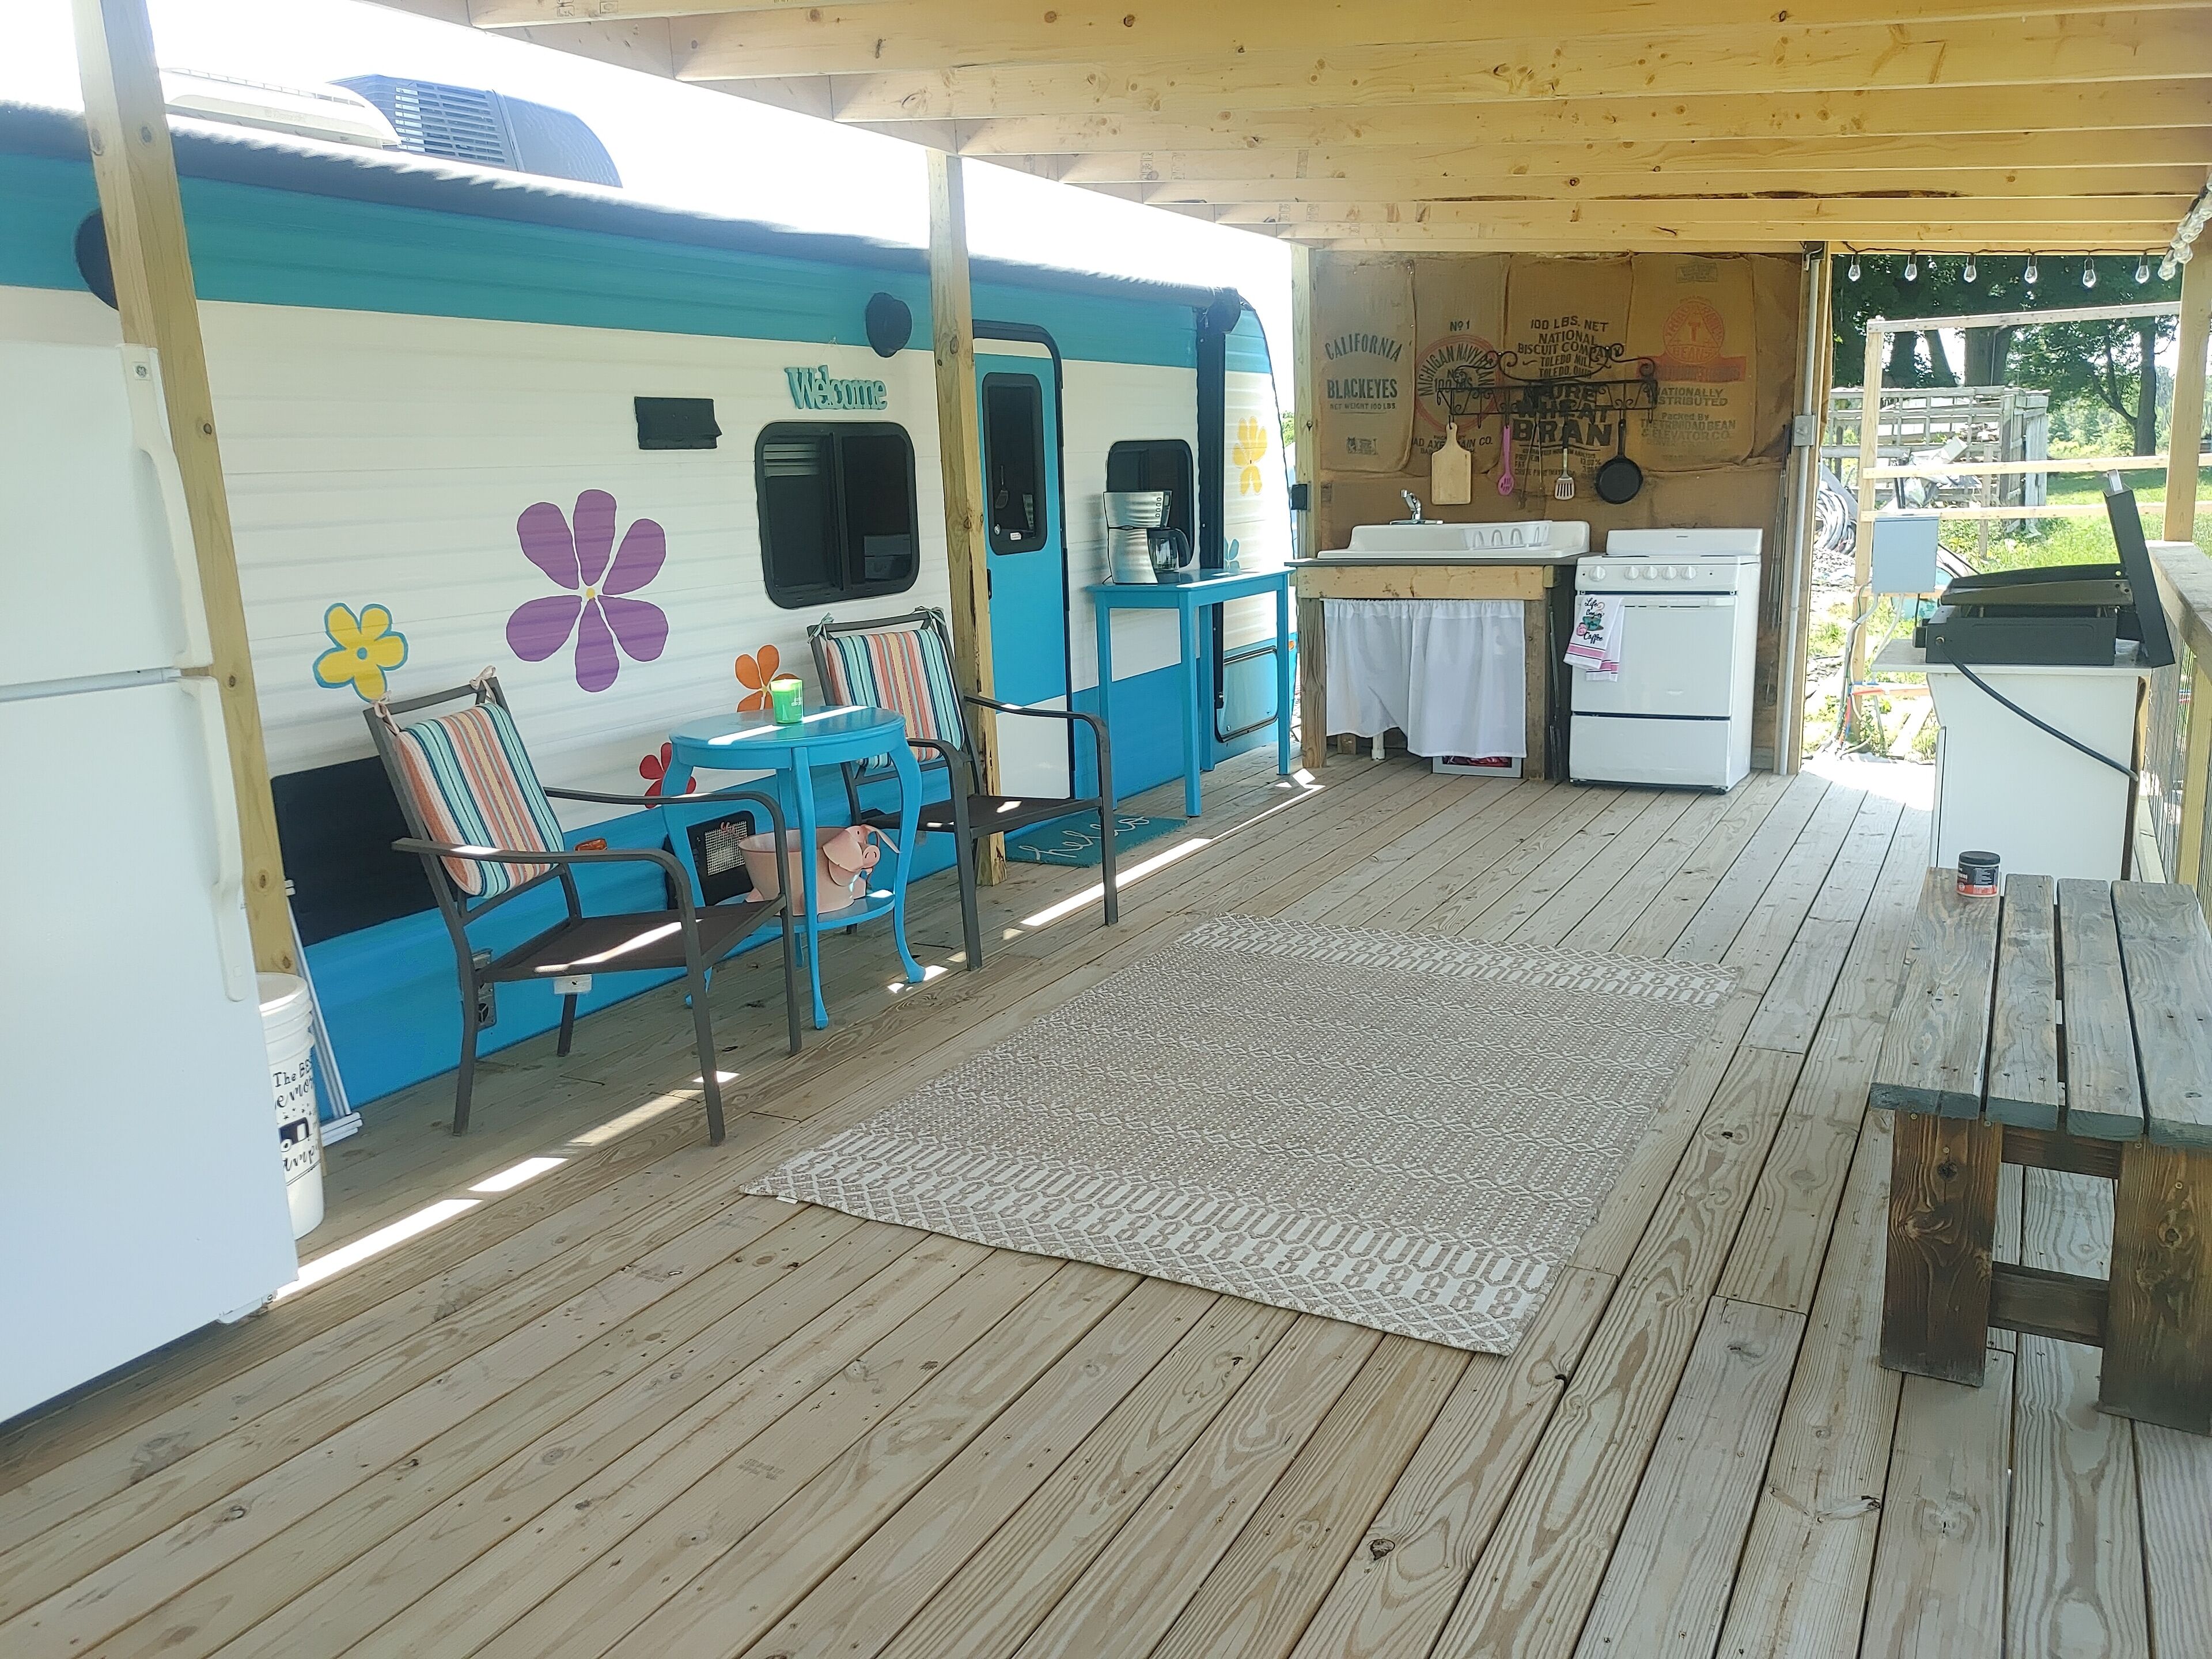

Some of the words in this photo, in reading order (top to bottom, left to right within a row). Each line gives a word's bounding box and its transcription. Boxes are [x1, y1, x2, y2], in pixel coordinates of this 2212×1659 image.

[1466, 320, 1471, 329] 1
[1531, 319, 1549, 330] 100
[1554, 315, 1581, 329] LBS.
[1585, 319, 1609, 332] NET
[1539, 329, 1598, 346] NATIONAL
[1325, 332, 1403, 362] CALIFORNIA
[1517, 342, 1558, 355] BISCUIT
[1540, 354, 1572, 368] TOLEDO
[1418, 346, 1456, 397] MICHIGAN
[1456, 343, 1480, 365] NAVY
[1539, 366, 1572, 378] TOLEDO,
[784, 364, 888, 410] Welcome
[1327, 378, 1398, 399] BLACKEYES
[1657, 387, 1724, 399] ATIONALLY
[1657, 396, 1729, 407] STRIBUTED
[1661, 412, 1695, 421] Packed
[1698, 412, 1710, 421] By
[1707, 419, 1736, 431] BEAN
[1512, 419, 1613, 446] BRAN
[1479, 435, 1493, 446] CO.
[1585, 597, 1598, 610] Life
[1584, 631, 1604, 645] Coffee
[272, 1071, 297, 1088] The
